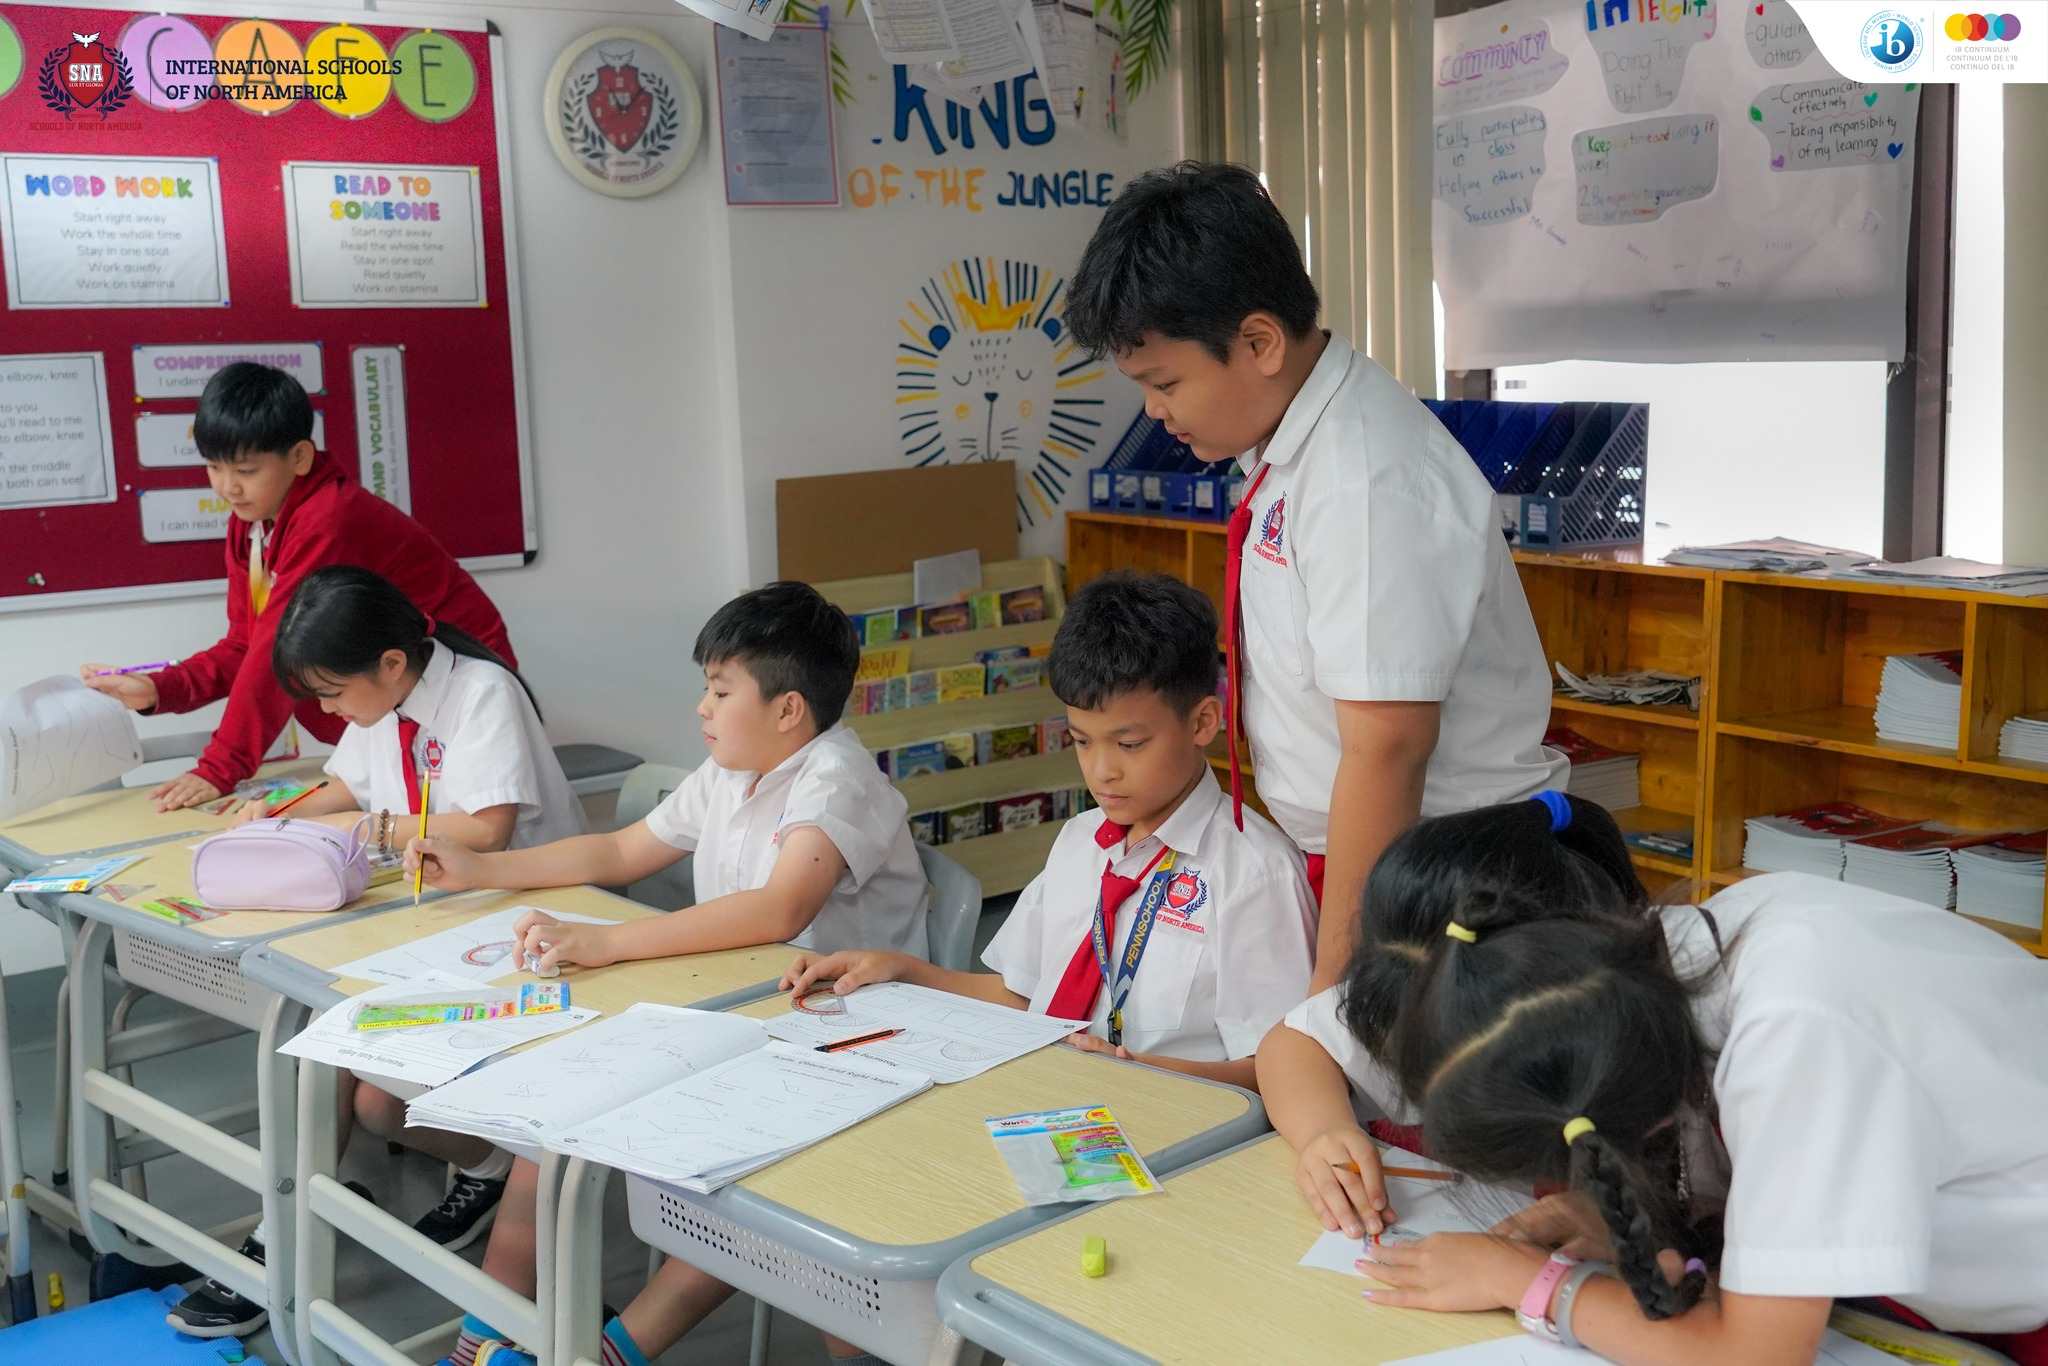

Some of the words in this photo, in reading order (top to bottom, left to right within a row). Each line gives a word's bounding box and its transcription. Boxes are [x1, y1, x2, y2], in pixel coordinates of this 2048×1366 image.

[1792, 96, 1847, 115] effectively
[1829, 117, 1898, 137] responsibility
[1814, 146, 1831, 162] my
[1835, 138, 1879, 158] learning
[25, 174, 106, 197] WORD
[115, 176, 193, 198] WORK
[334, 174, 391, 197] READ
[398, 176, 432, 198] TO
[849, 164, 904, 208] OF
[914, 166, 986, 213] THE
[997, 169, 1114, 209] JUNGLE
[330, 200, 441, 222] SOMEONE
[73, 211, 103, 224] Start
[106, 211, 132, 226] right
[136, 213, 167, 225] away
[60, 228, 94, 240] Work
[97, 228, 116, 240] the
[119, 228, 153, 240] whole
[156, 229, 182, 240] time
[351, 226, 376, 238] Start
[379, 226, 404, 240] right
[405, 228, 433, 240] away
[77, 245, 103, 258] Stay
[106, 245, 117, 256] in
[120, 246, 142, 257] one
[144, 245, 170, 259] spot
[340, 240, 367, 251] Read
[370, 240, 388, 251] the
[390, 241, 421, 252] whole
[422, 241, 445, 252] time
[88, 262, 121, 273] Work
[124, 261, 162, 275] quietly
[353, 255, 376, 267] Stay
[391, 256, 410, 266] one
[364, 268, 391, 280] Read
[393, 268, 427, 282] quietly
[77, 279, 109, 290] Work
[112, 280, 128, 290] on
[130, 278, 175, 290] stamina
[353, 283, 381, 293] Work
[50, 369, 79, 380] knee
[16, 404, 38, 415] you
[365, 356, 384, 456] VOCABULARY
[19, 416, 46, 427] read
[50, 415, 65, 426] to
[56, 430, 85, 441] knee
[9, 462, 28, 473] the
[32, 459, 71, 472] middle
[7, 477, 40, 489] both
[43, 476, 59, 487] can
[374, 461, 387, 498] PAND
[168, 522, 189, 531] can
[193, 519, 217, 530] read
[1126, 878, 1164, 968] PENNSCHOOL
